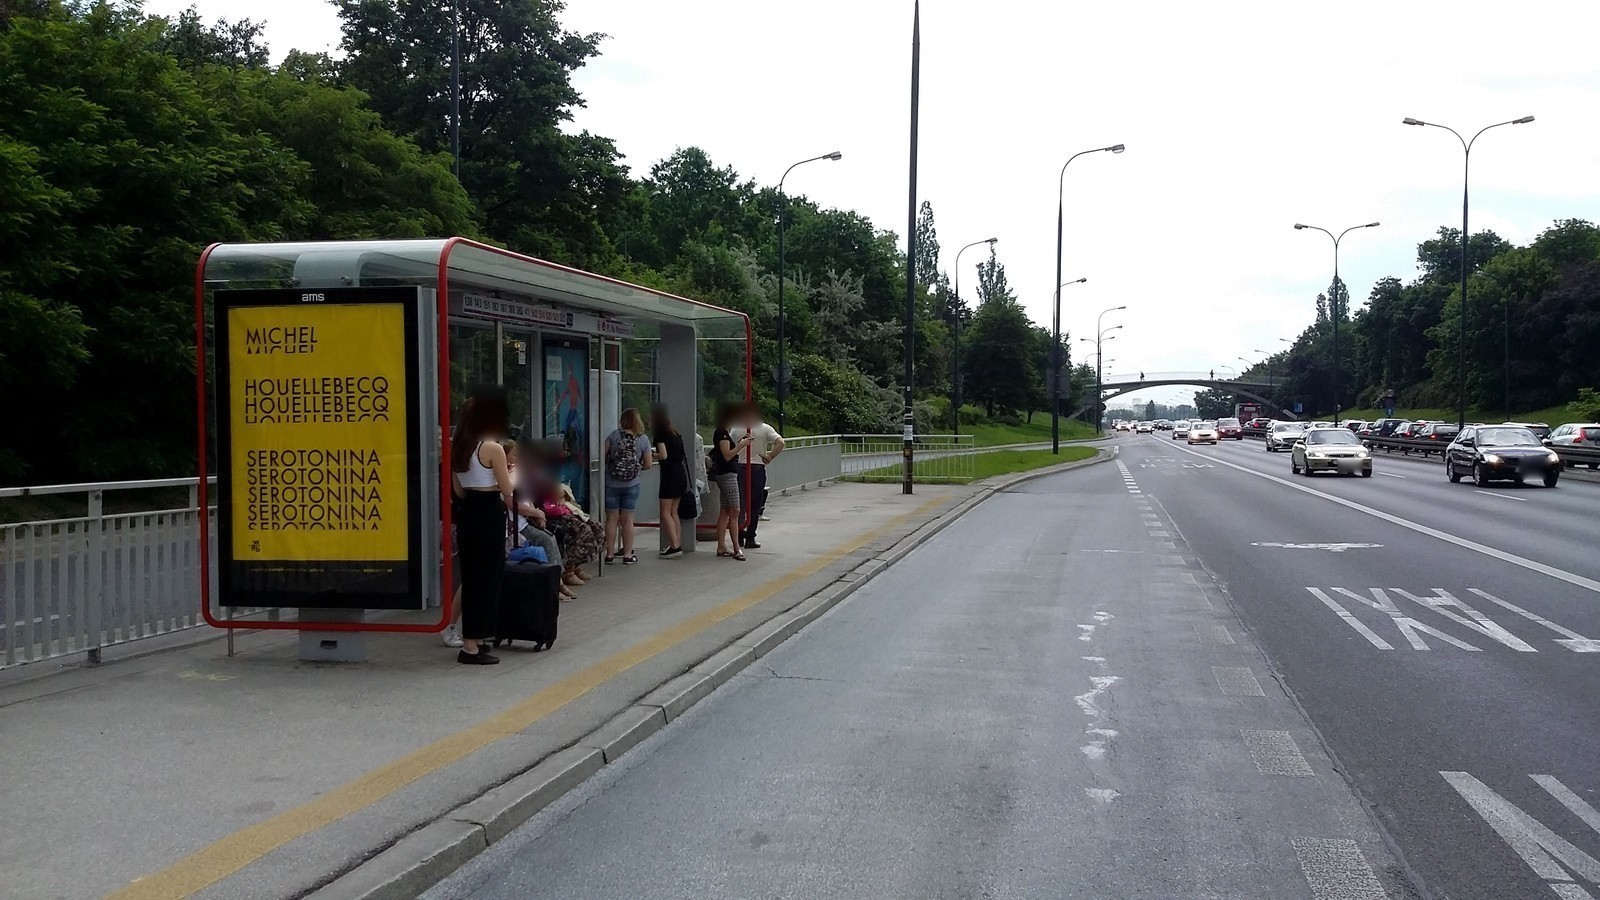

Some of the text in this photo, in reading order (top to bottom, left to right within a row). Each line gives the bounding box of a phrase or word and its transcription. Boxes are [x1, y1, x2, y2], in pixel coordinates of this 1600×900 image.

[302, 293, 325, 302] ams
[246, 326, 318, 344] MICHEL
[245, 376, 389, 396] HOUELLEBECQ
[245, 395, 389, 414] HOUELLEBECQ
[247, 449, 381, 467] SEROTONINA
[247, 467, 381, 486] SEROTONINA
[248, 486, 382, 504] SEROTONINA
[248, 504, 382, 521] SEROTONINA
